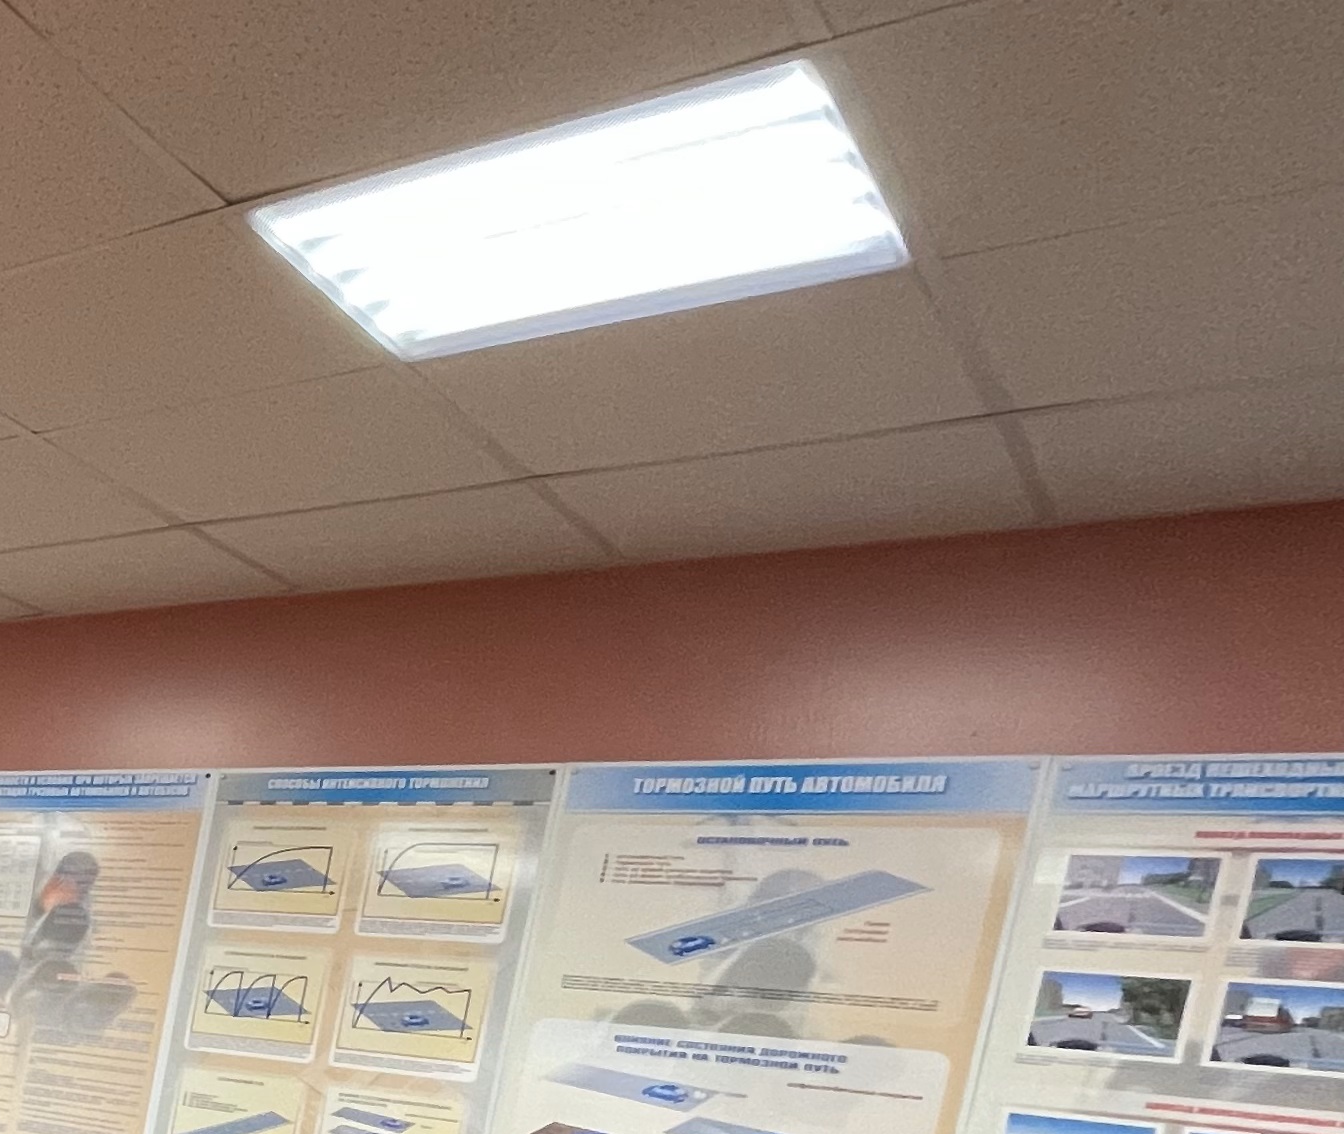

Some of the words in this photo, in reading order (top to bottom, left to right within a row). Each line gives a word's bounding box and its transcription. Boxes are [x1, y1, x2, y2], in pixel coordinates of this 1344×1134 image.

[267, 778, 321, 790] СПОСОБЫ
[409, 777, 490, 790] ТОРМОЖЕНИЯ
[633, 773, 746, 794] ТОРМОЗНОЙ
[749, 776, 798, 793] ПУТЬ
[801, 775, 947, 794] АВТОМОБИЛЯ
[616, 1045, 687, 1059] ПОКРЫТИЯ
[692, 1053, 708, 1061] НА
[715, 1055, 799, 1070] ТОРМОЗНОЙ
[804, 1063, 840, 1074] ПУТЬ
[677, 1040, 756, 1055] СОСТОЯНИЯ
[759, 1047, 848, 1063] ДОРОЖНОГО
